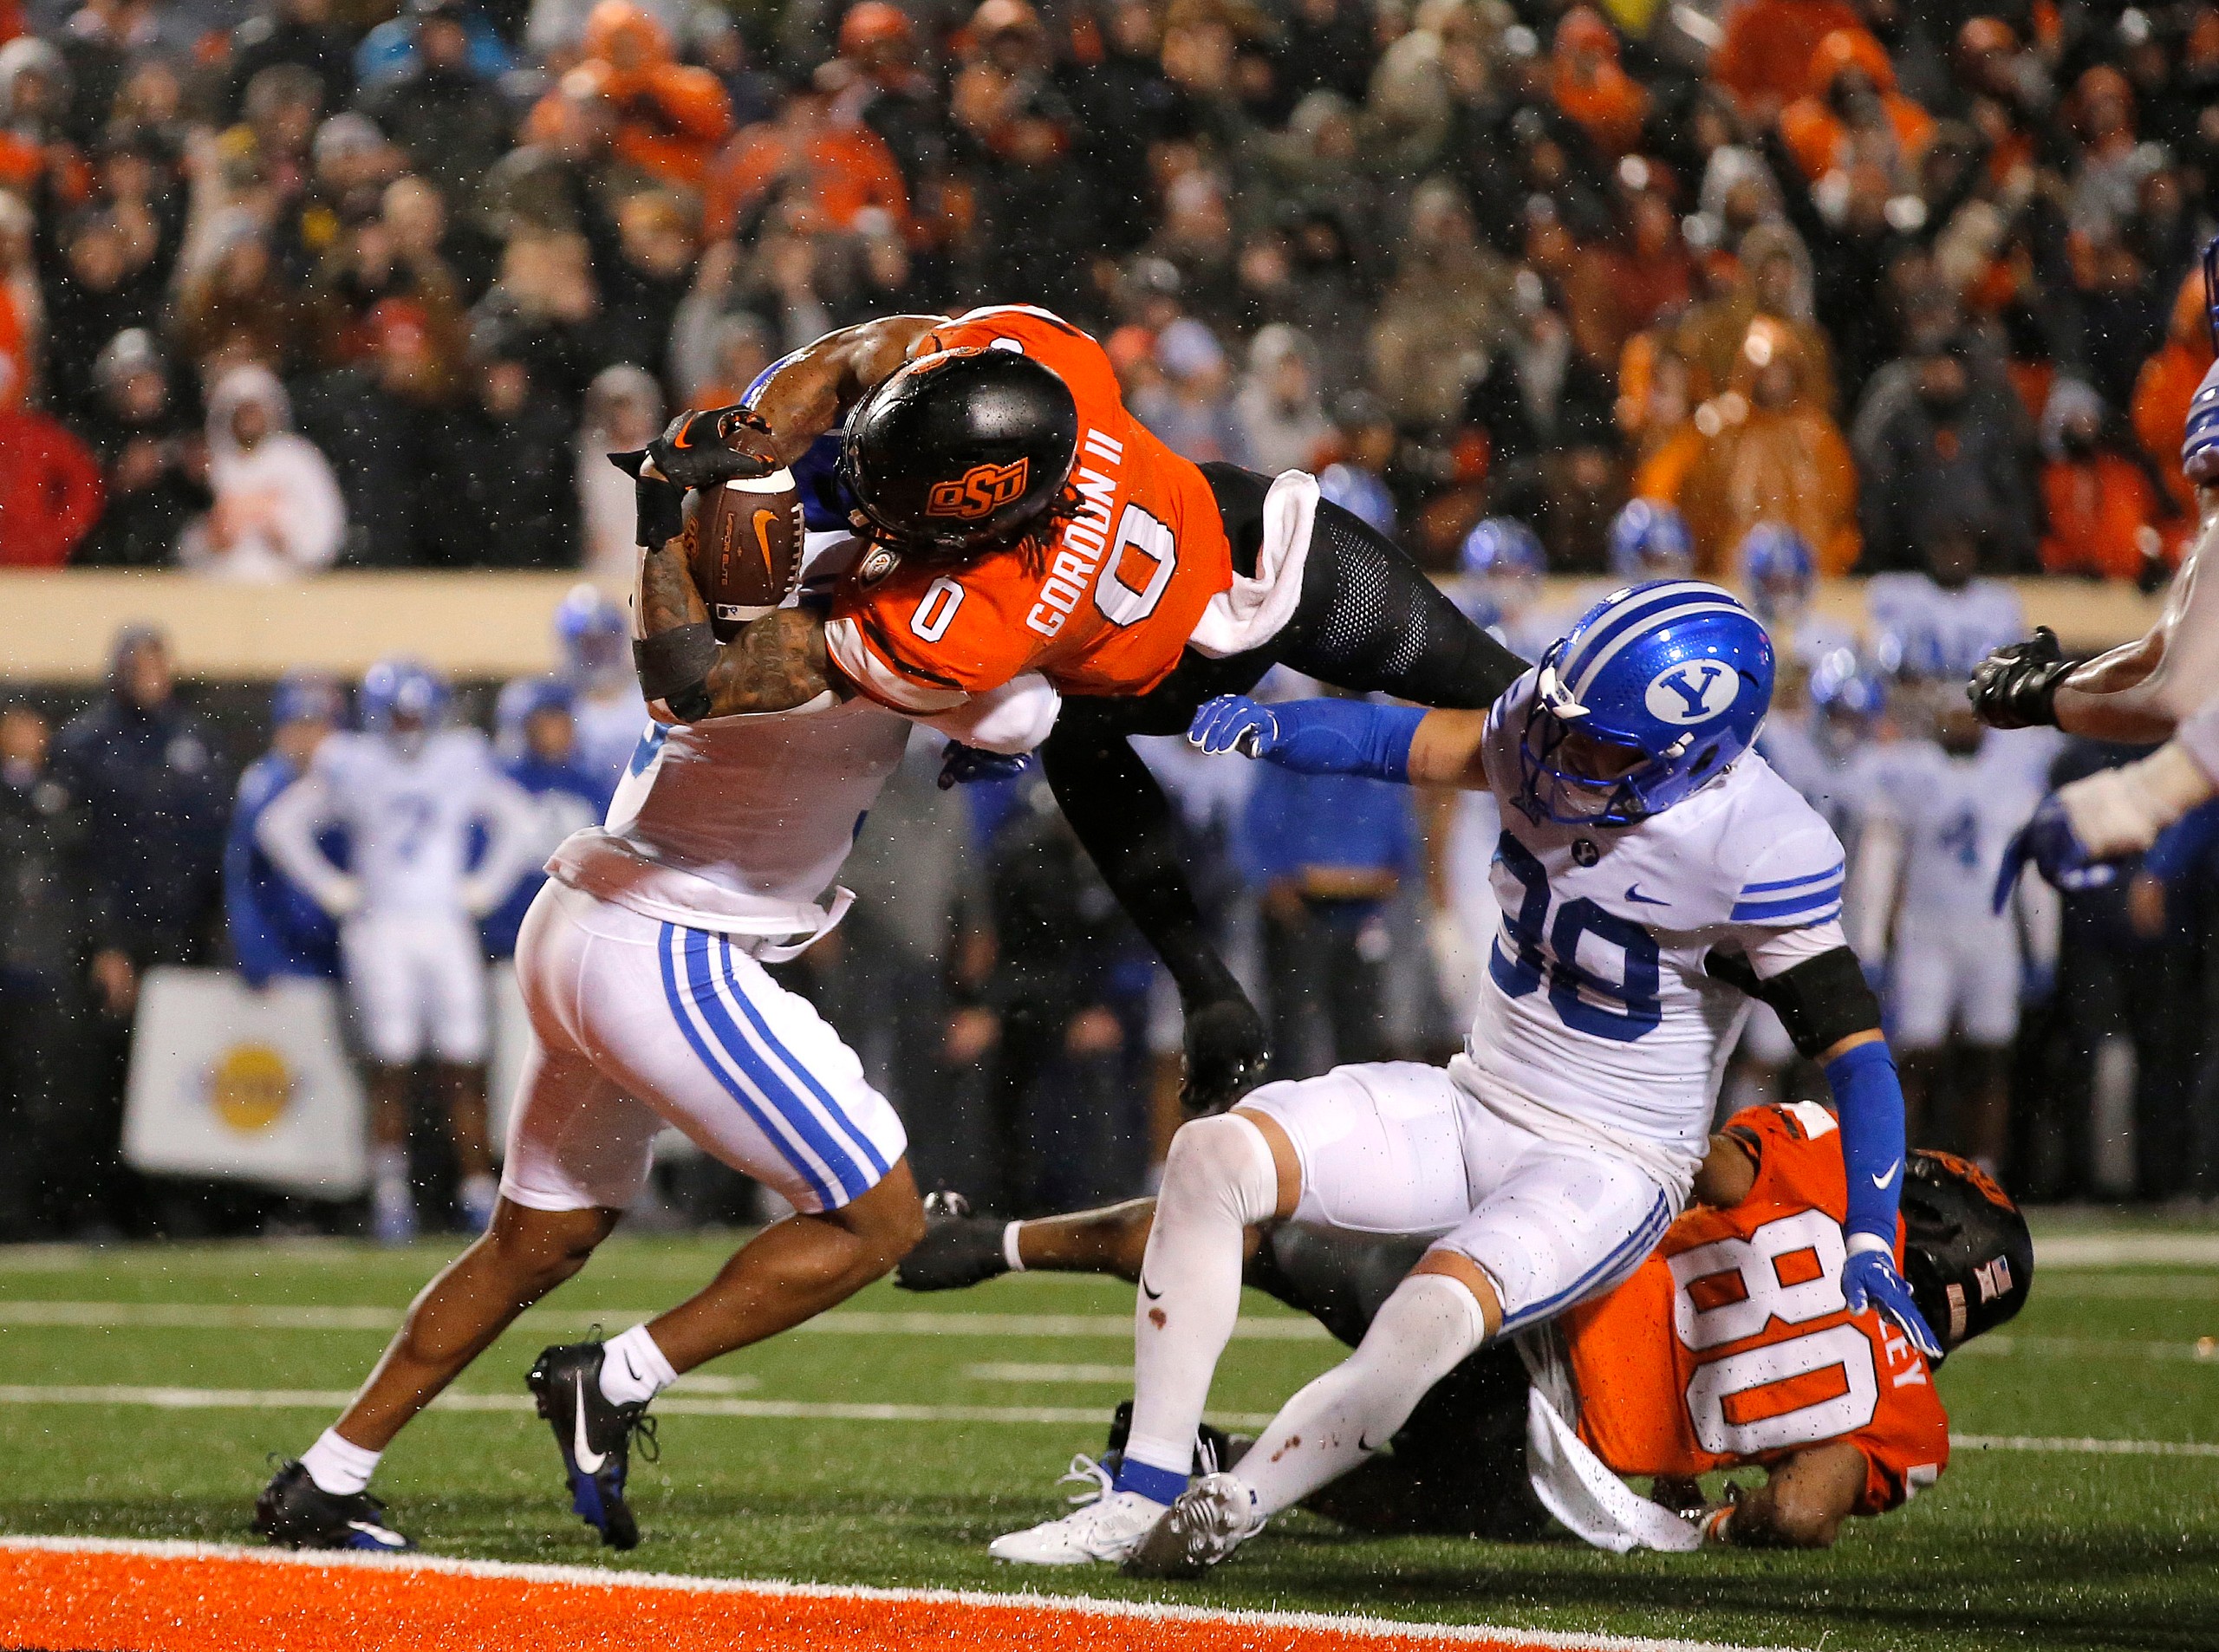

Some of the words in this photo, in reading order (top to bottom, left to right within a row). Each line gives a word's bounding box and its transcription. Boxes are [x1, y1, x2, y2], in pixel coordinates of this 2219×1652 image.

[925, 456, 1029, 519] OSU
[1026, 466, 1117, 637] GORDON
[1084, 427, 1123, 465] II
[908, 576, 966, 643] 0
[1094, 501, 1177, 628] 0
[1658, 666, 1722, 719] Y
[1666, 1207, 1878, 1455] 80
